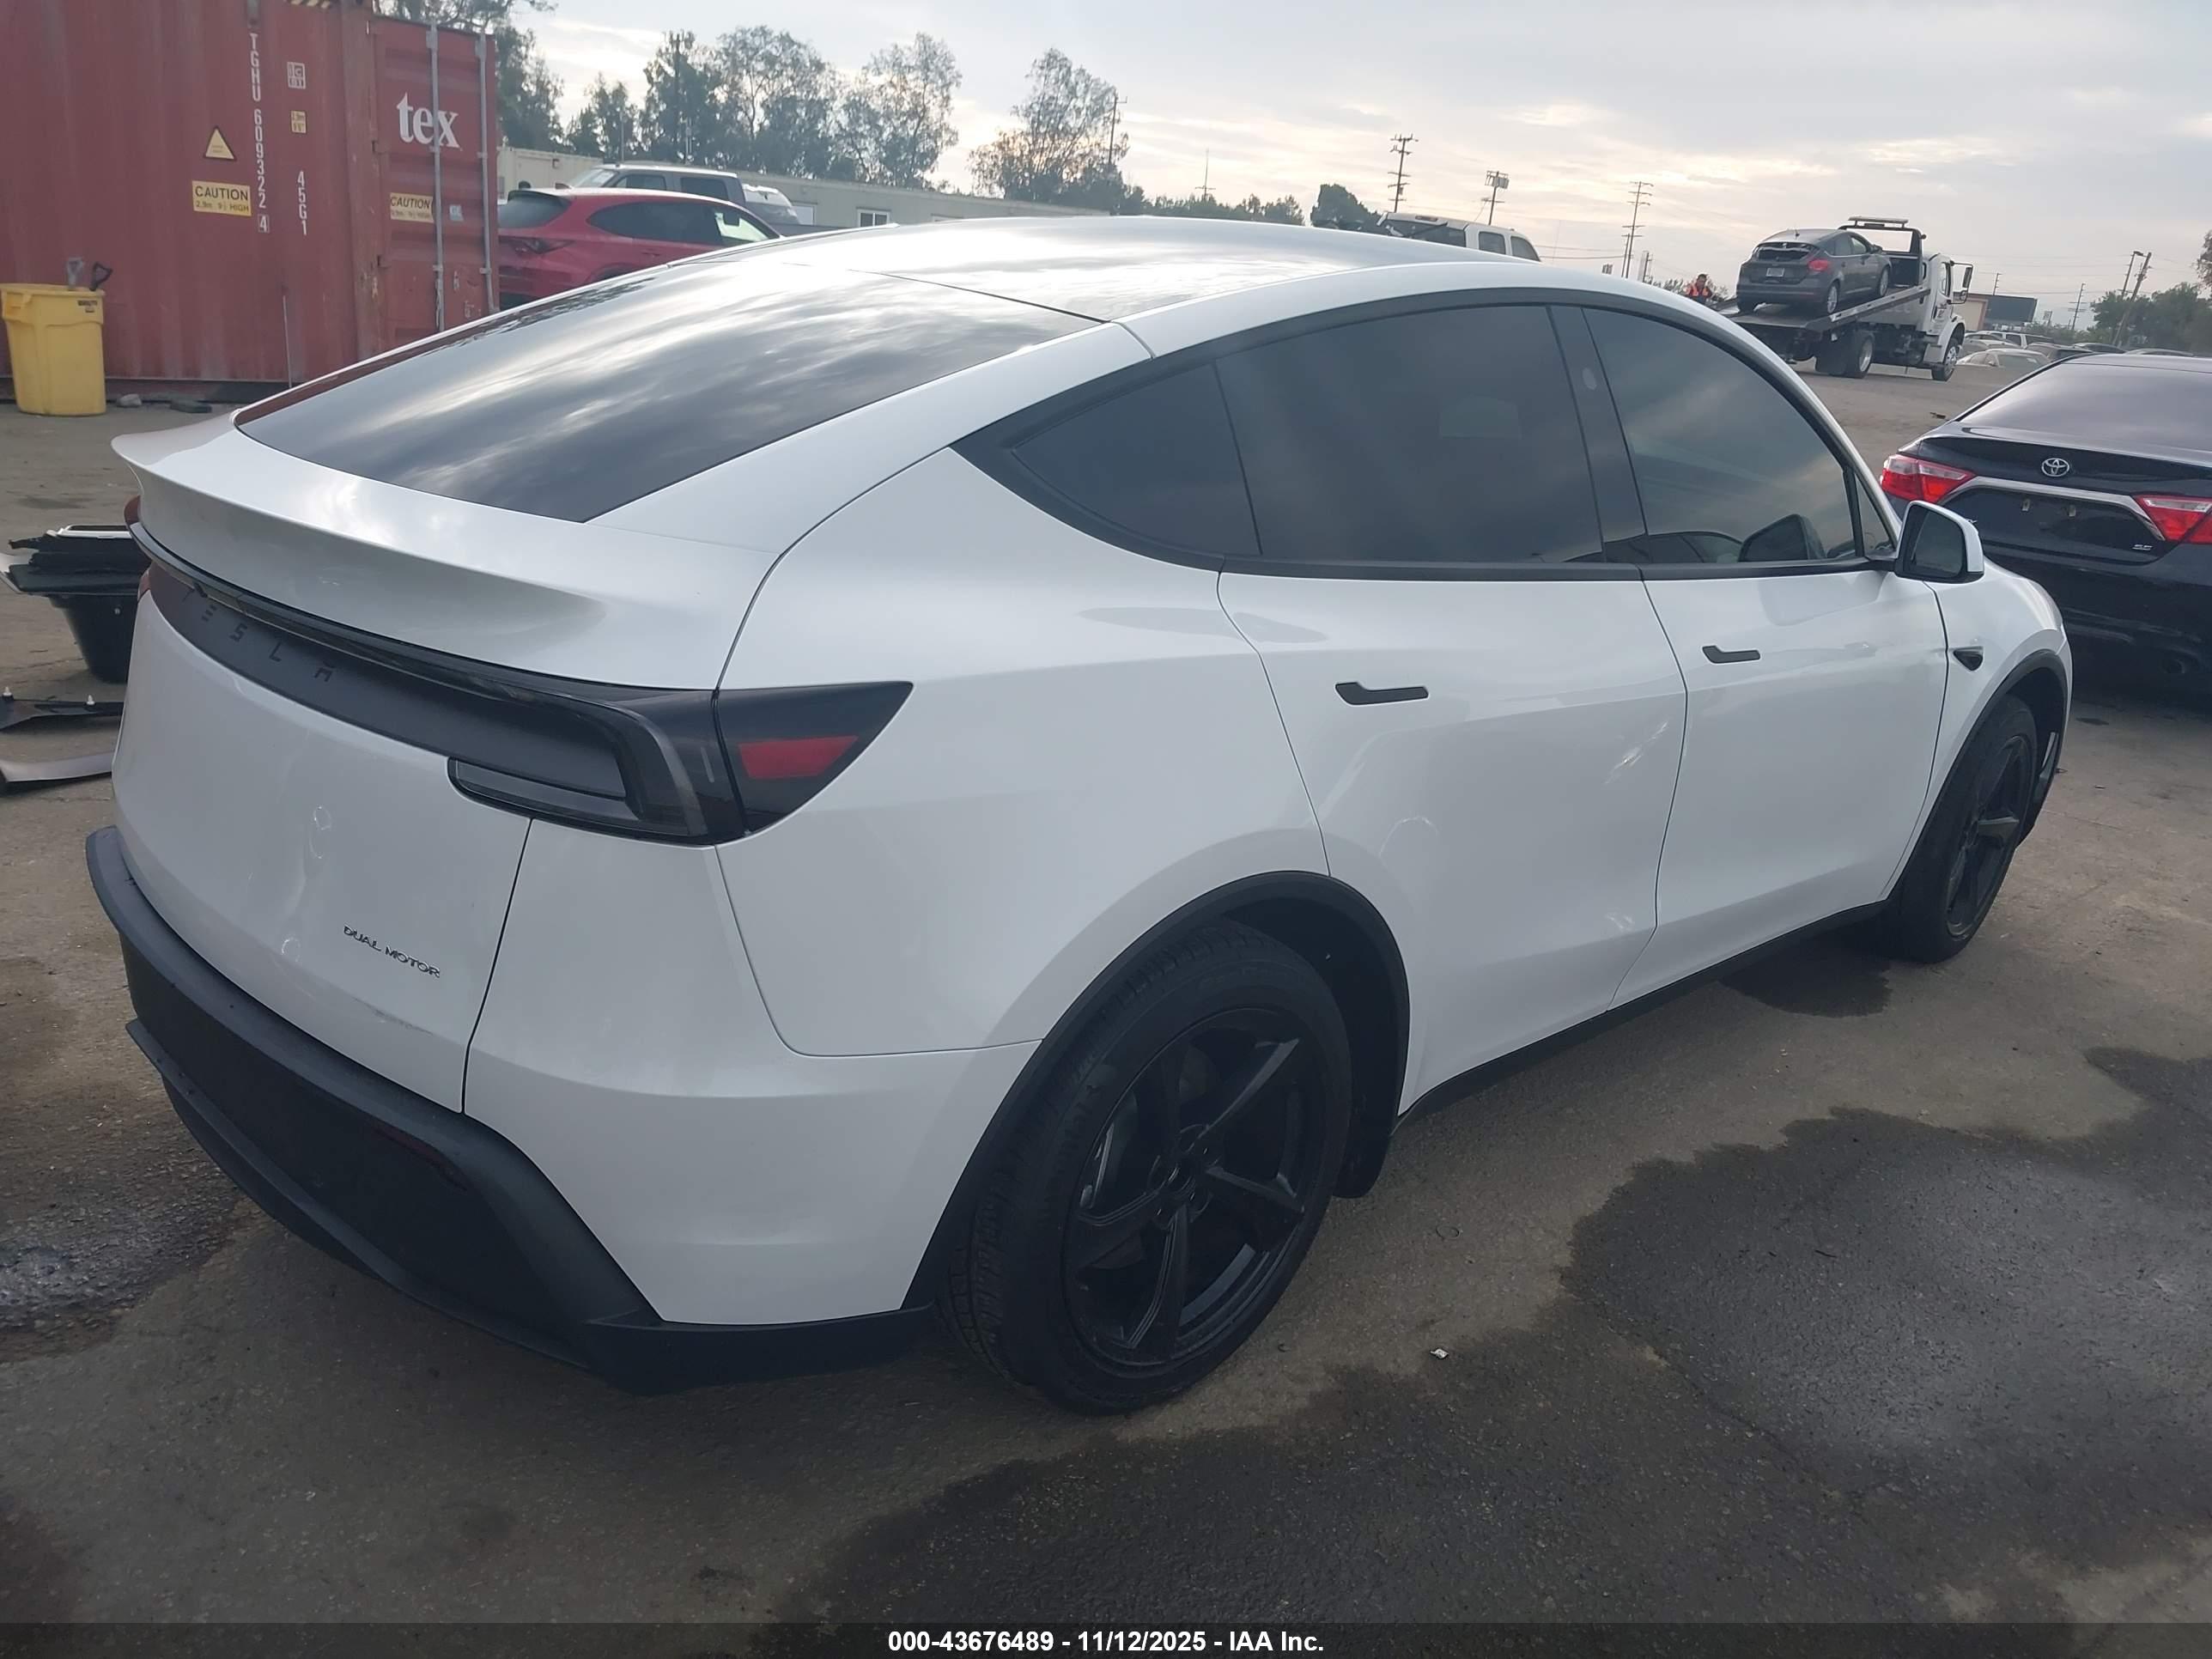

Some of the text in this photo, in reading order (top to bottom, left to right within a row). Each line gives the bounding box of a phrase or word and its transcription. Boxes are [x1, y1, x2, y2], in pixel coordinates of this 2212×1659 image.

[250, 33, 261, 101] TGHU
[396, 91, 459, 149] tex
[254, 108, 266, 208] 609322
[195, 185, 248, 201] CAUTION
[297, 170, 307, 236] 45G1
[390, 196, 430, 209] CAUTION
[343, 925, 441, 979] DUAL MOTOR
